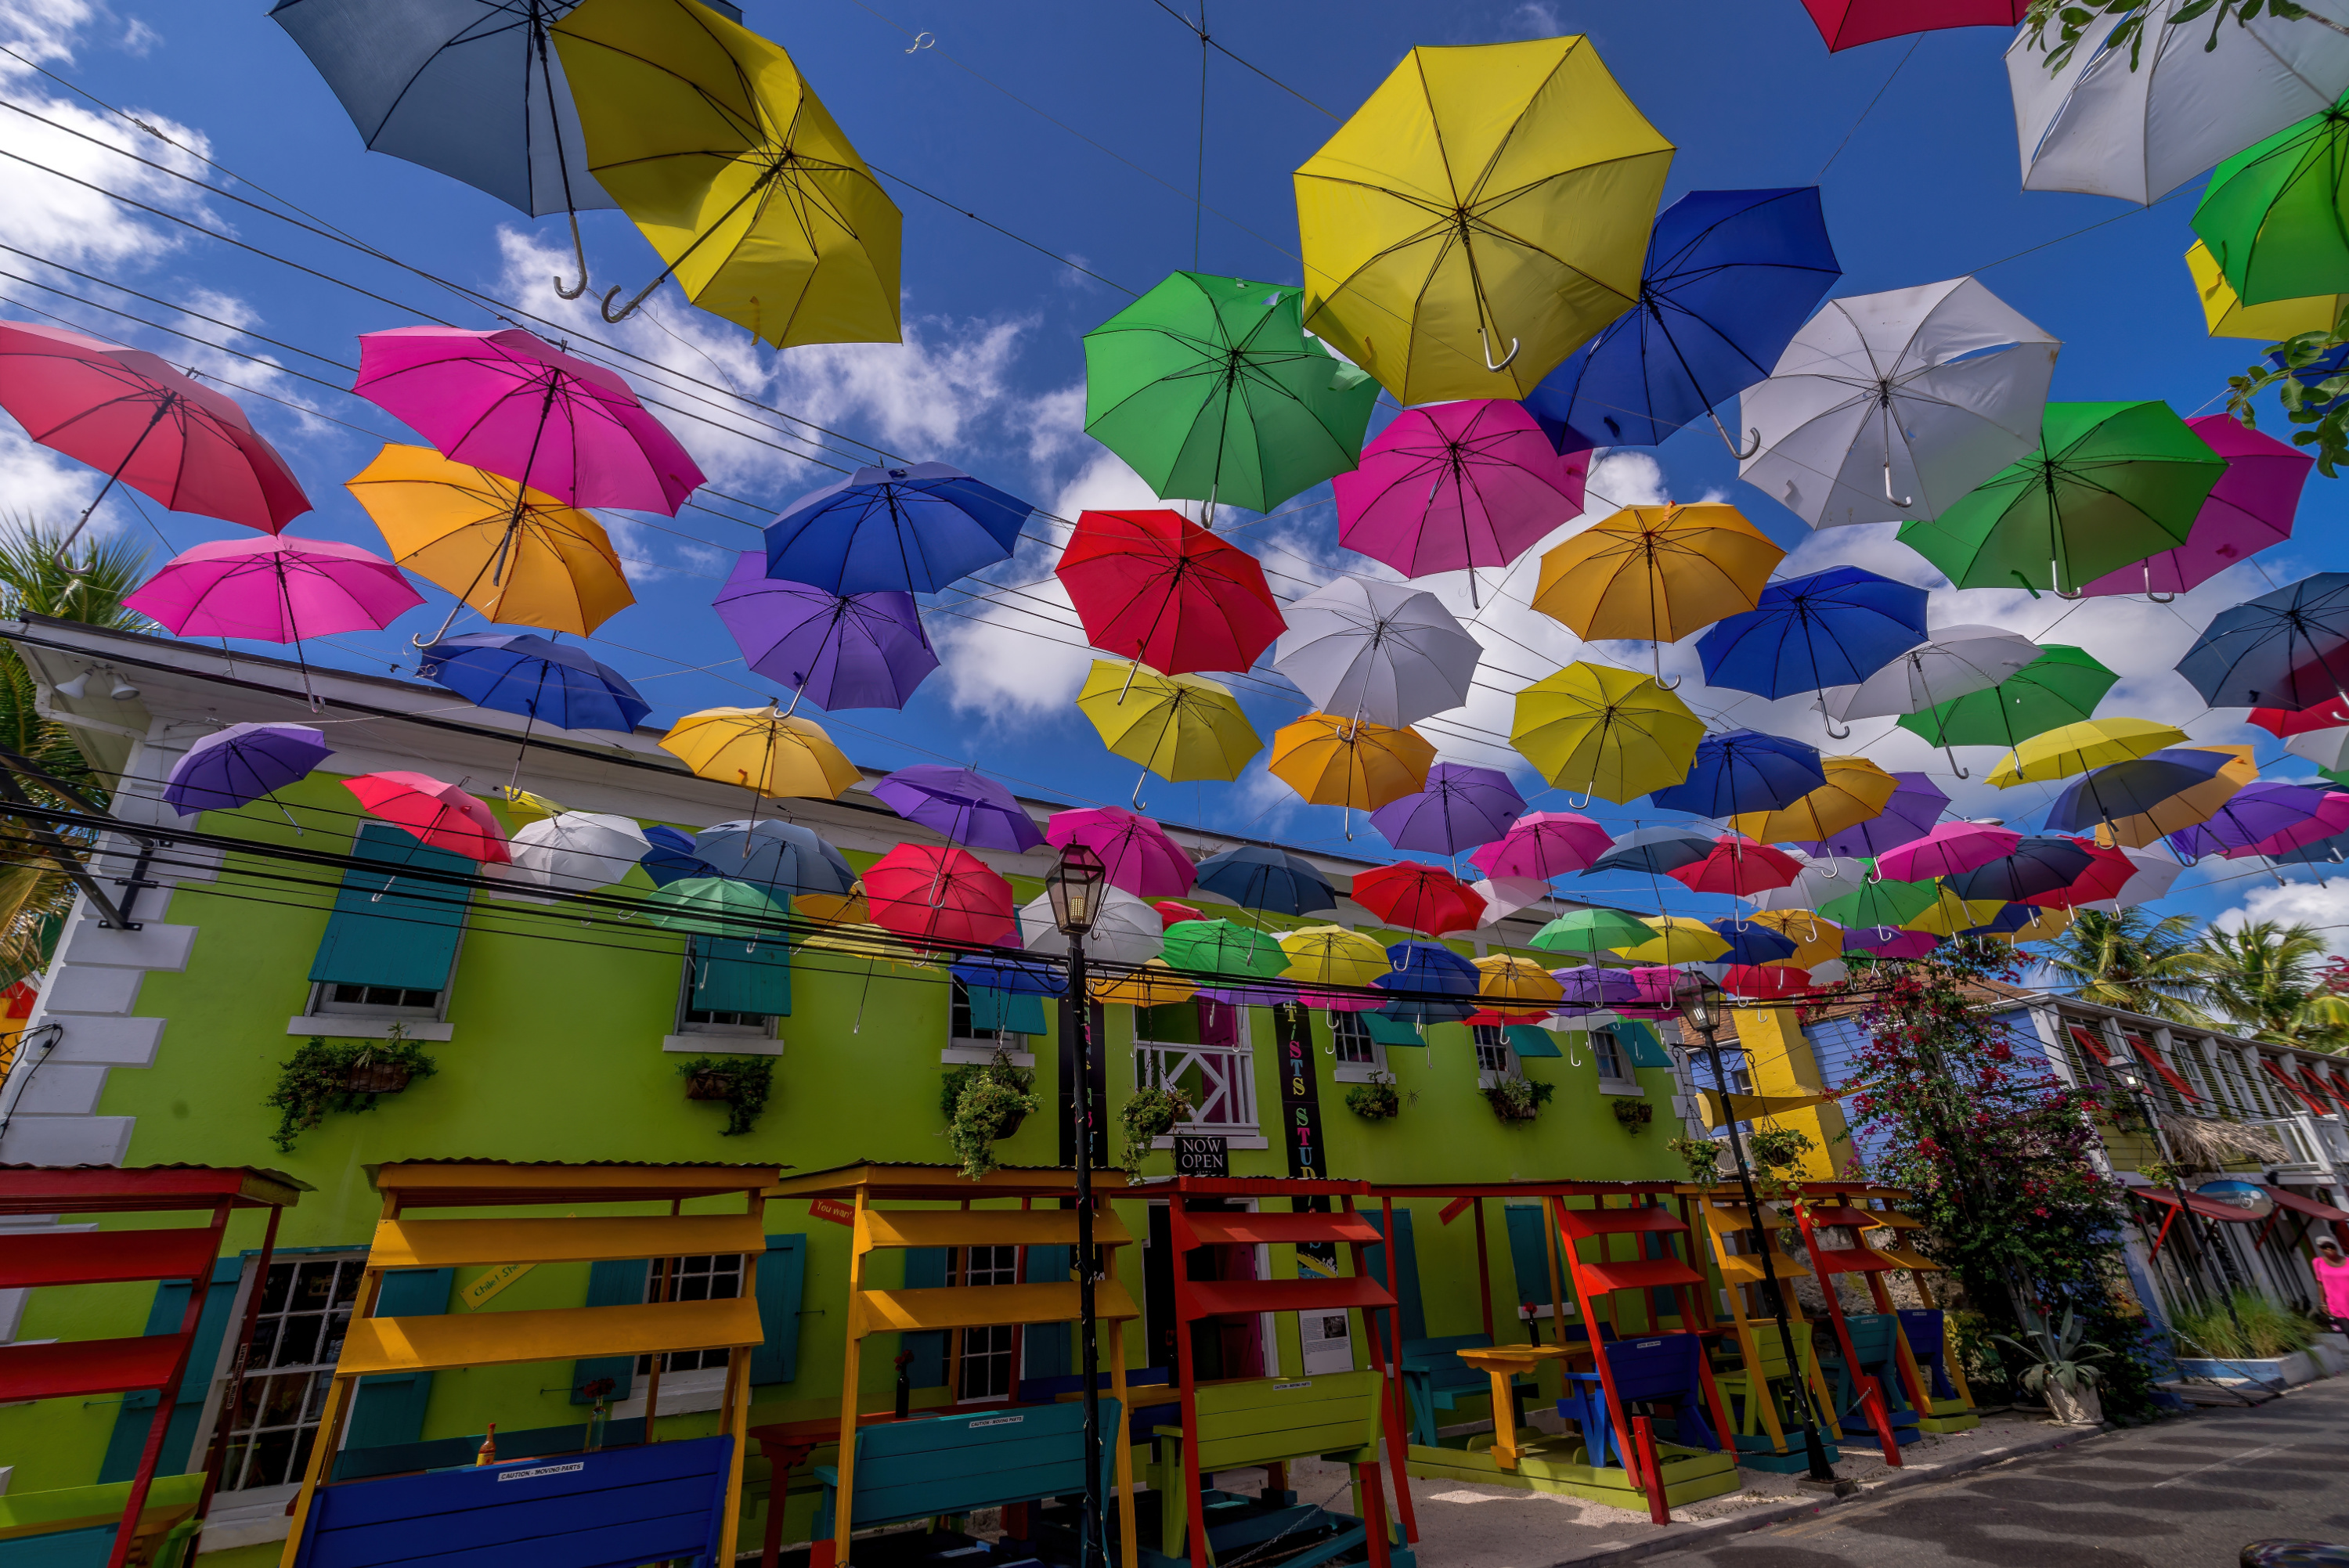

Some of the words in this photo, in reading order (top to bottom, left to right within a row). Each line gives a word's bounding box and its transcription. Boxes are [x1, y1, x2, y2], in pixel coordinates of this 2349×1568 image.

[1182, 1139, 1221, 1154] NOW
[1182, 1154, 1224, 1168] OPEN
[817, 1200, 832, 1213] You
[474, 1274, 502, 1296] Chile!
[501, 1471, 530, 1480] CAUTION
